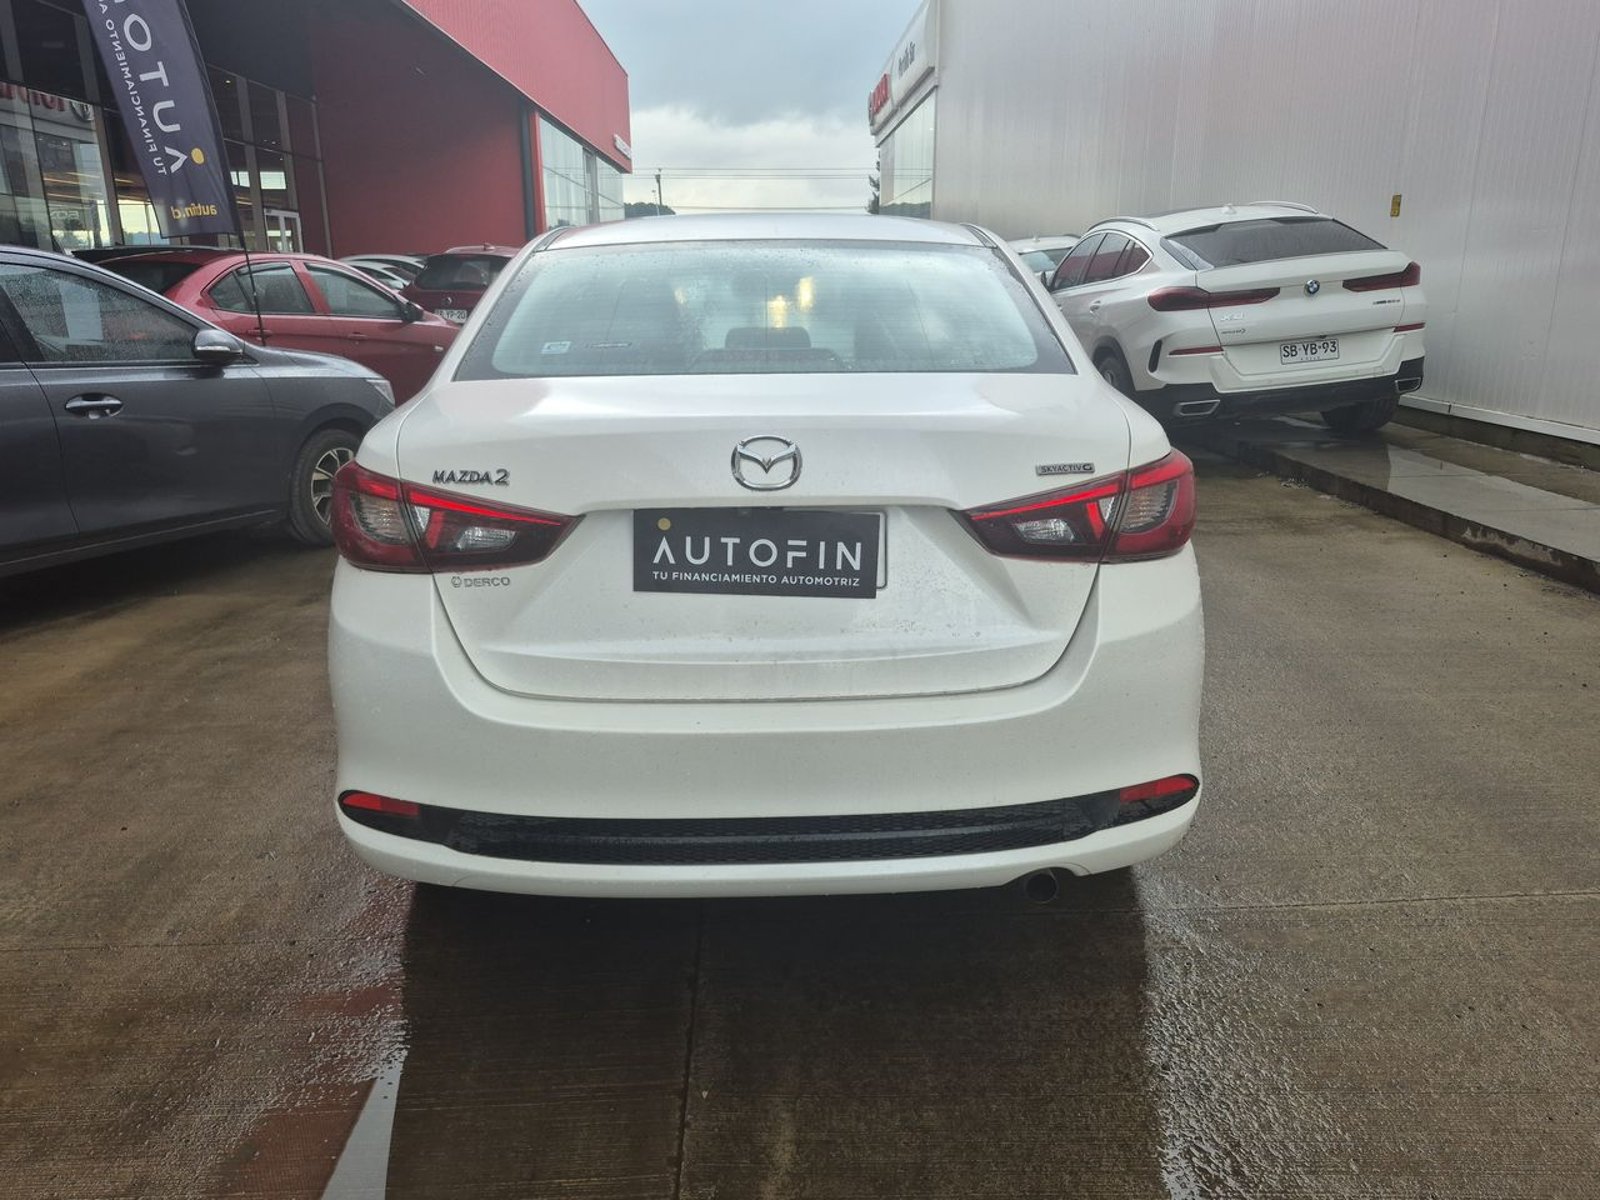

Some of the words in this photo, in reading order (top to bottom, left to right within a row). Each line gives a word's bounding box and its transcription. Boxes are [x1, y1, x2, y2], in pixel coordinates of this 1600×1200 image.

[652, 535, 862, 571] AUTOFIN
[463, 576, 510, 588] DERCO
[652, 571, 668, 581] TU
[671, 571, 777, 584] FINANCIAMIENTO
[781, 575, 860, 587] AUTOMOTRIZ
